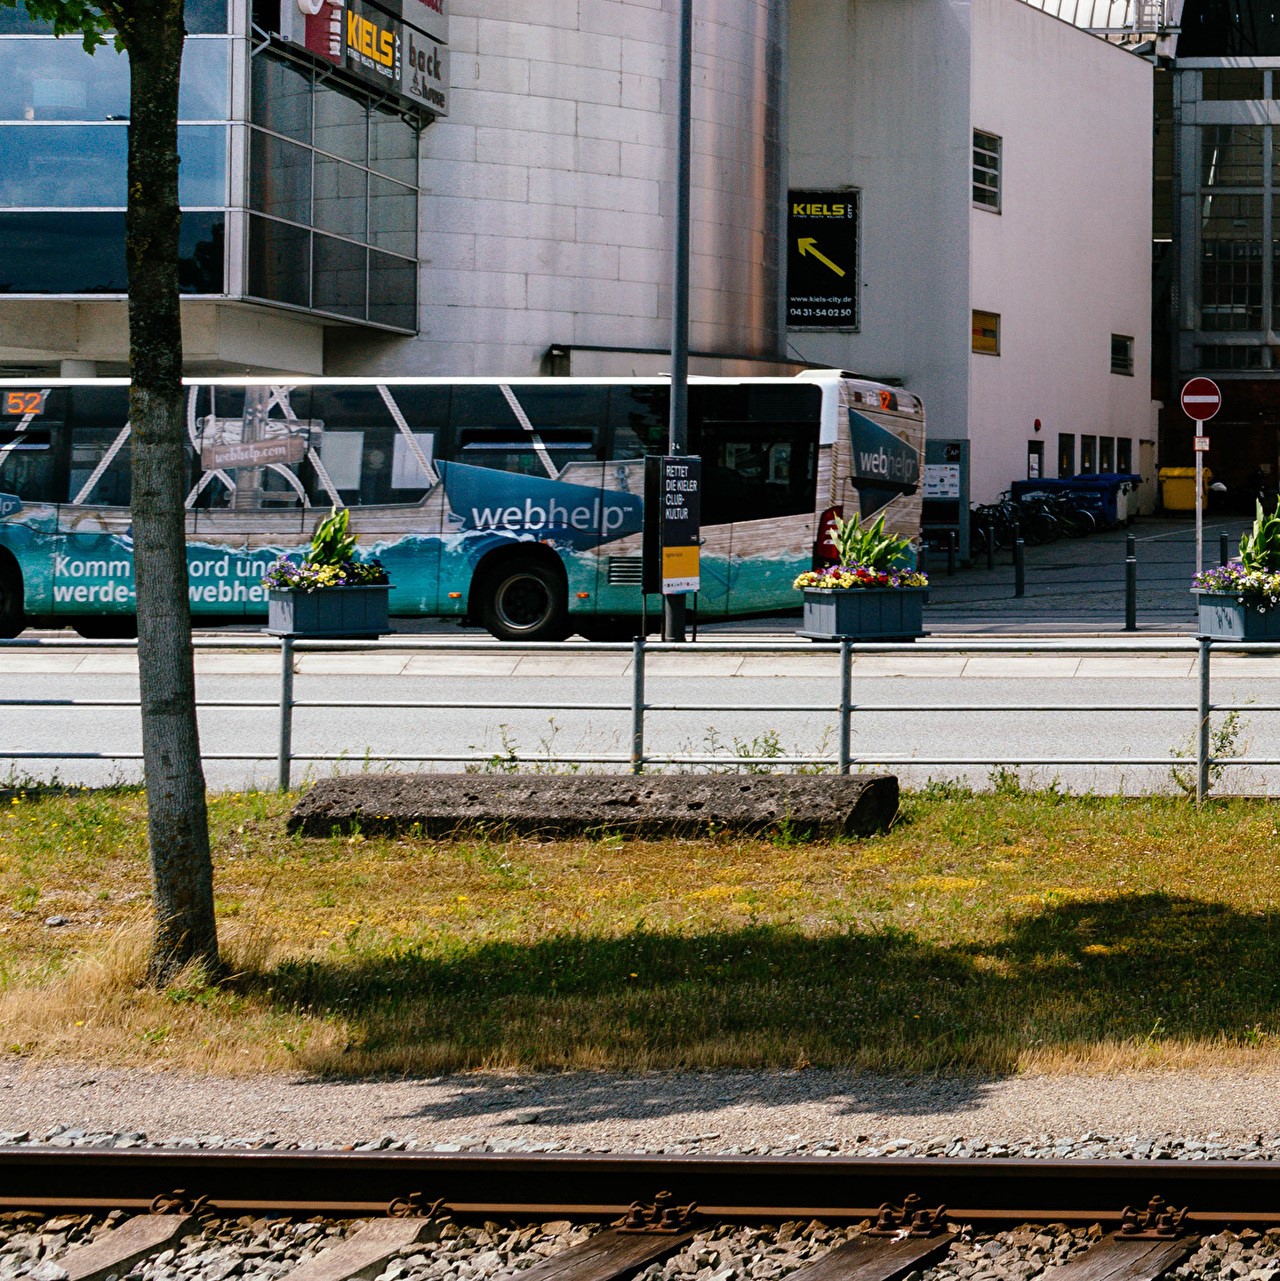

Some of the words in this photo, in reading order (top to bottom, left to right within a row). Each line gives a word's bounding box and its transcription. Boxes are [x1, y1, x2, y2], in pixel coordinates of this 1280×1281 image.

[409, 33, 441, 81] back
[421, 75, 446, 108] house
[793, 204, 845, 215] KIELS
[790, 296, 852, 304] www.kiels-city.de
[7, 392, 42, 414] 52
[215, 444, 286, 463] webhelp.com
[666, 465, 689, 477] RETTET
[666, 479, 677, 491] DIE
[677, 480, 697, 491] KIELER
[665, 493, 685, 505] CLUB-
[665, 508, 688, 519] KULTUR
[54, 556, 130, 577] Komm
[187, 555, 229, 577] ord
